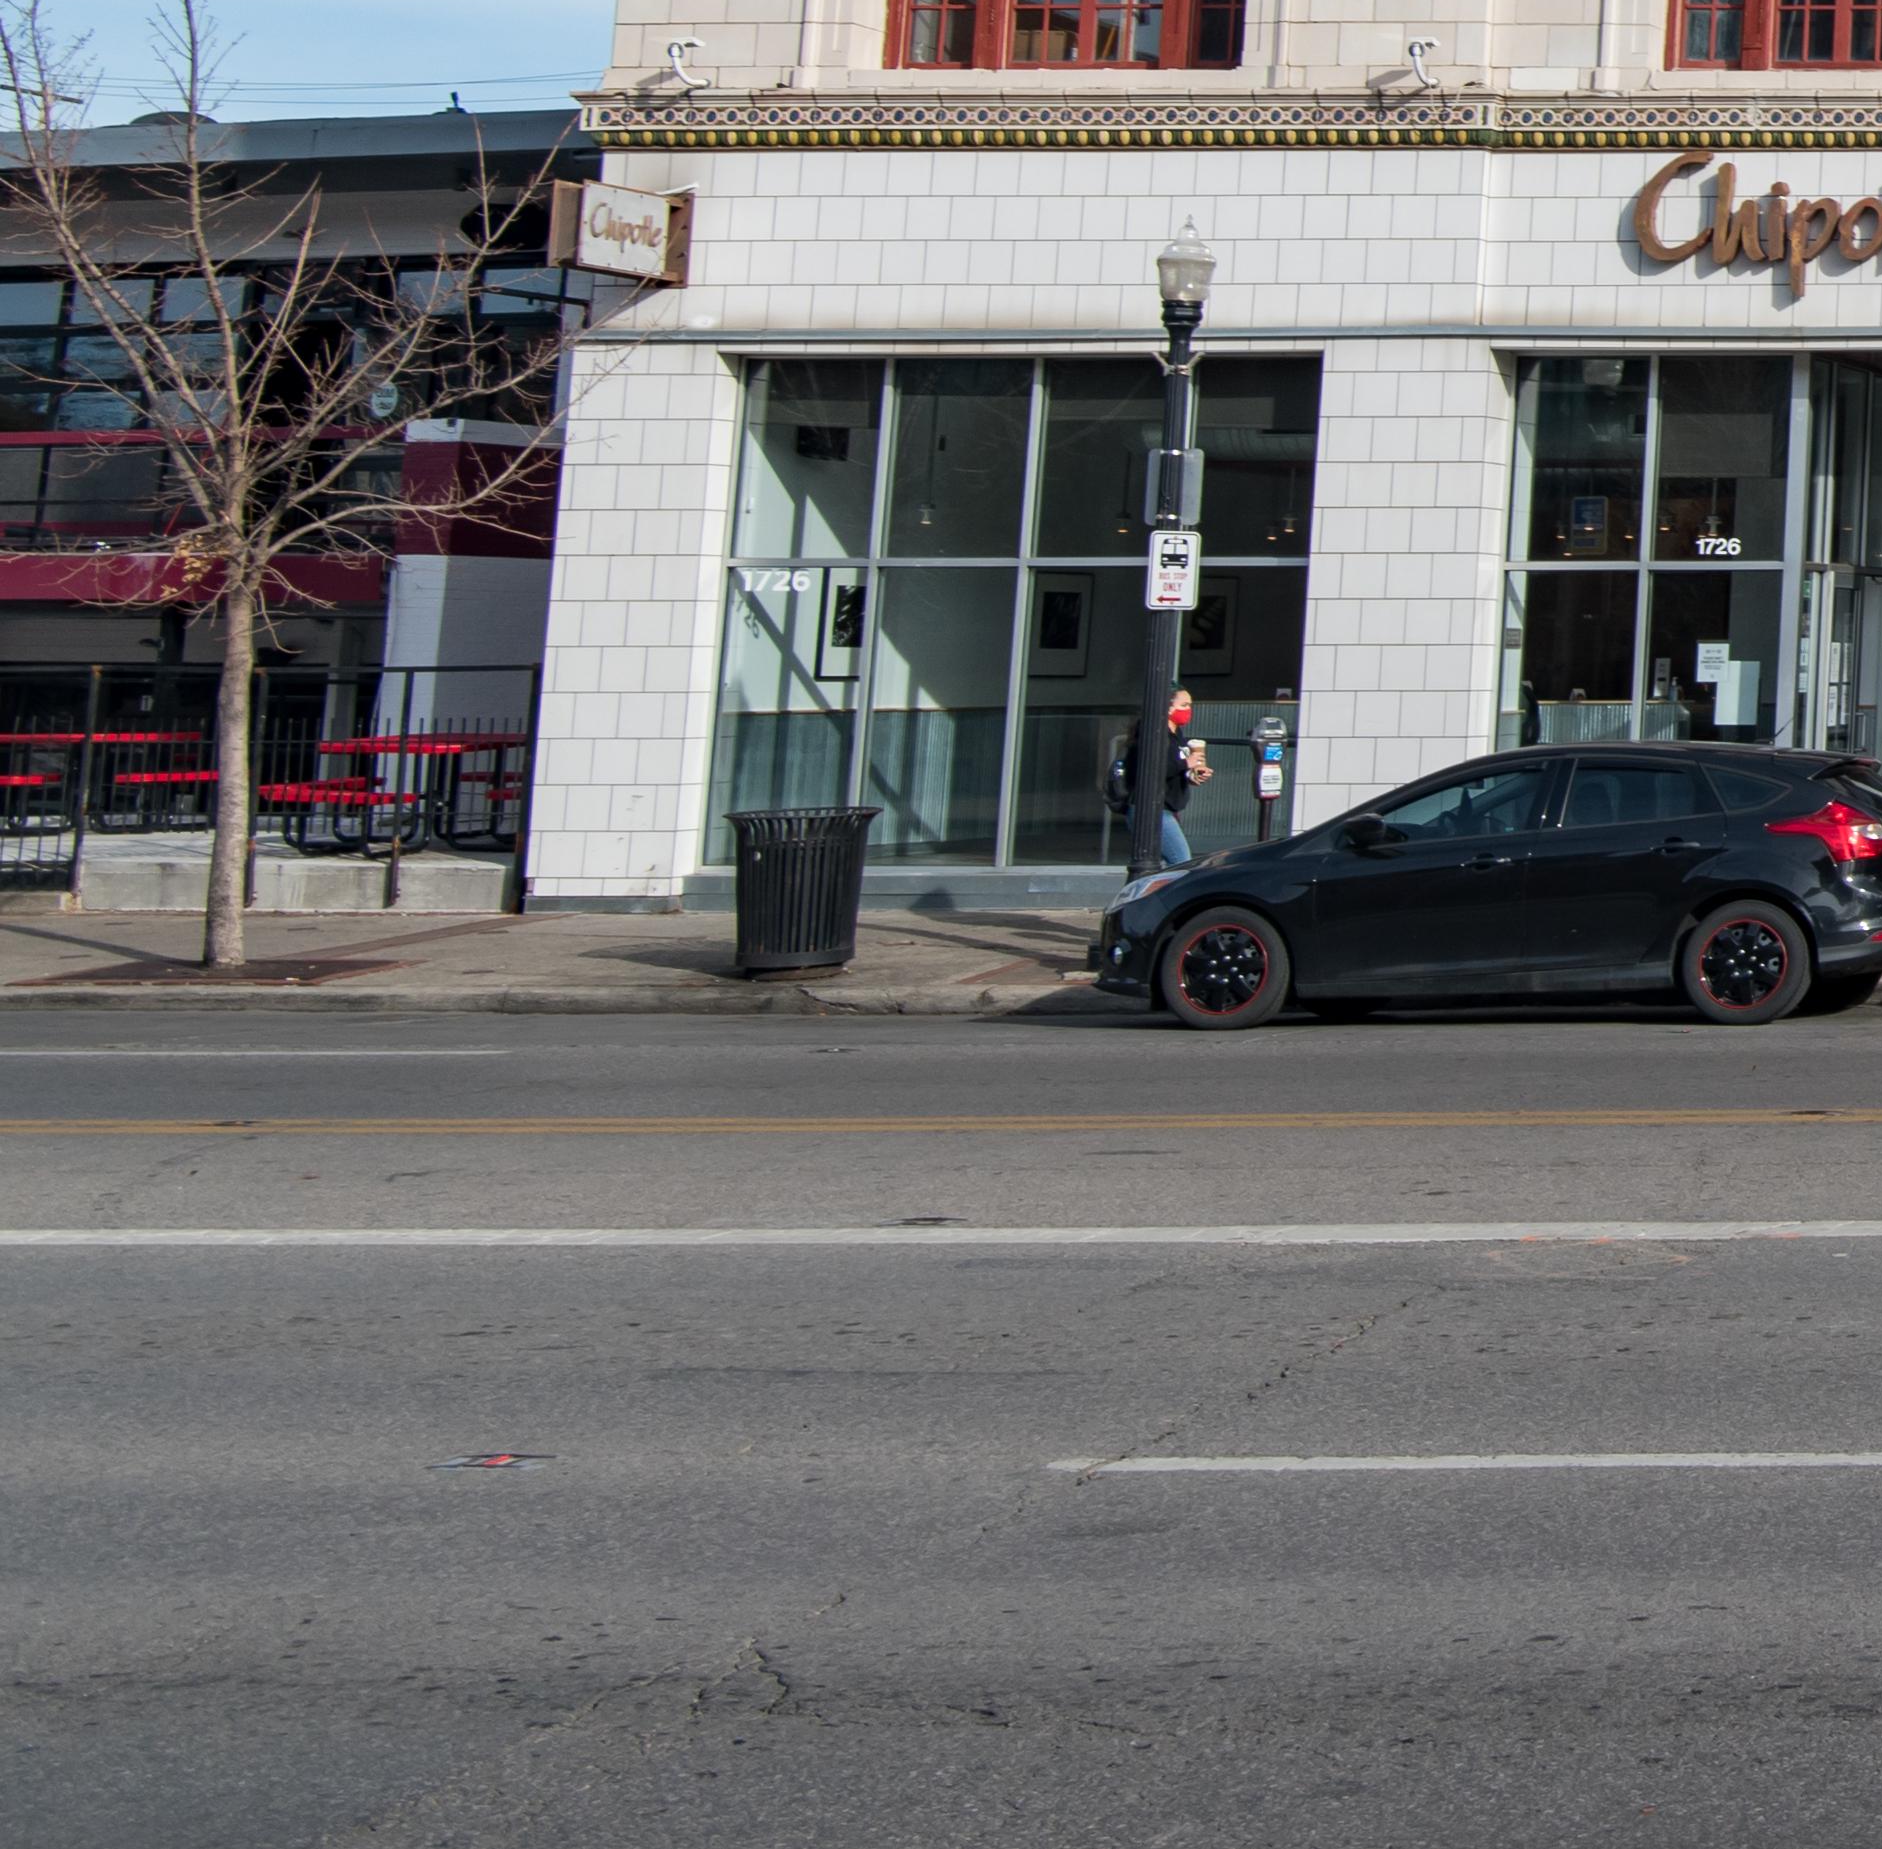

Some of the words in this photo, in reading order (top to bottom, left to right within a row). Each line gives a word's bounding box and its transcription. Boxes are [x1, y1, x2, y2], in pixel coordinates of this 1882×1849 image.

[590, 202, 663, 254] Chipotle
[1695, 537, 1742, 556] 1726
[741, 570, 812, 592] 1726
[1162, 582, 1183, 592] ONLY
